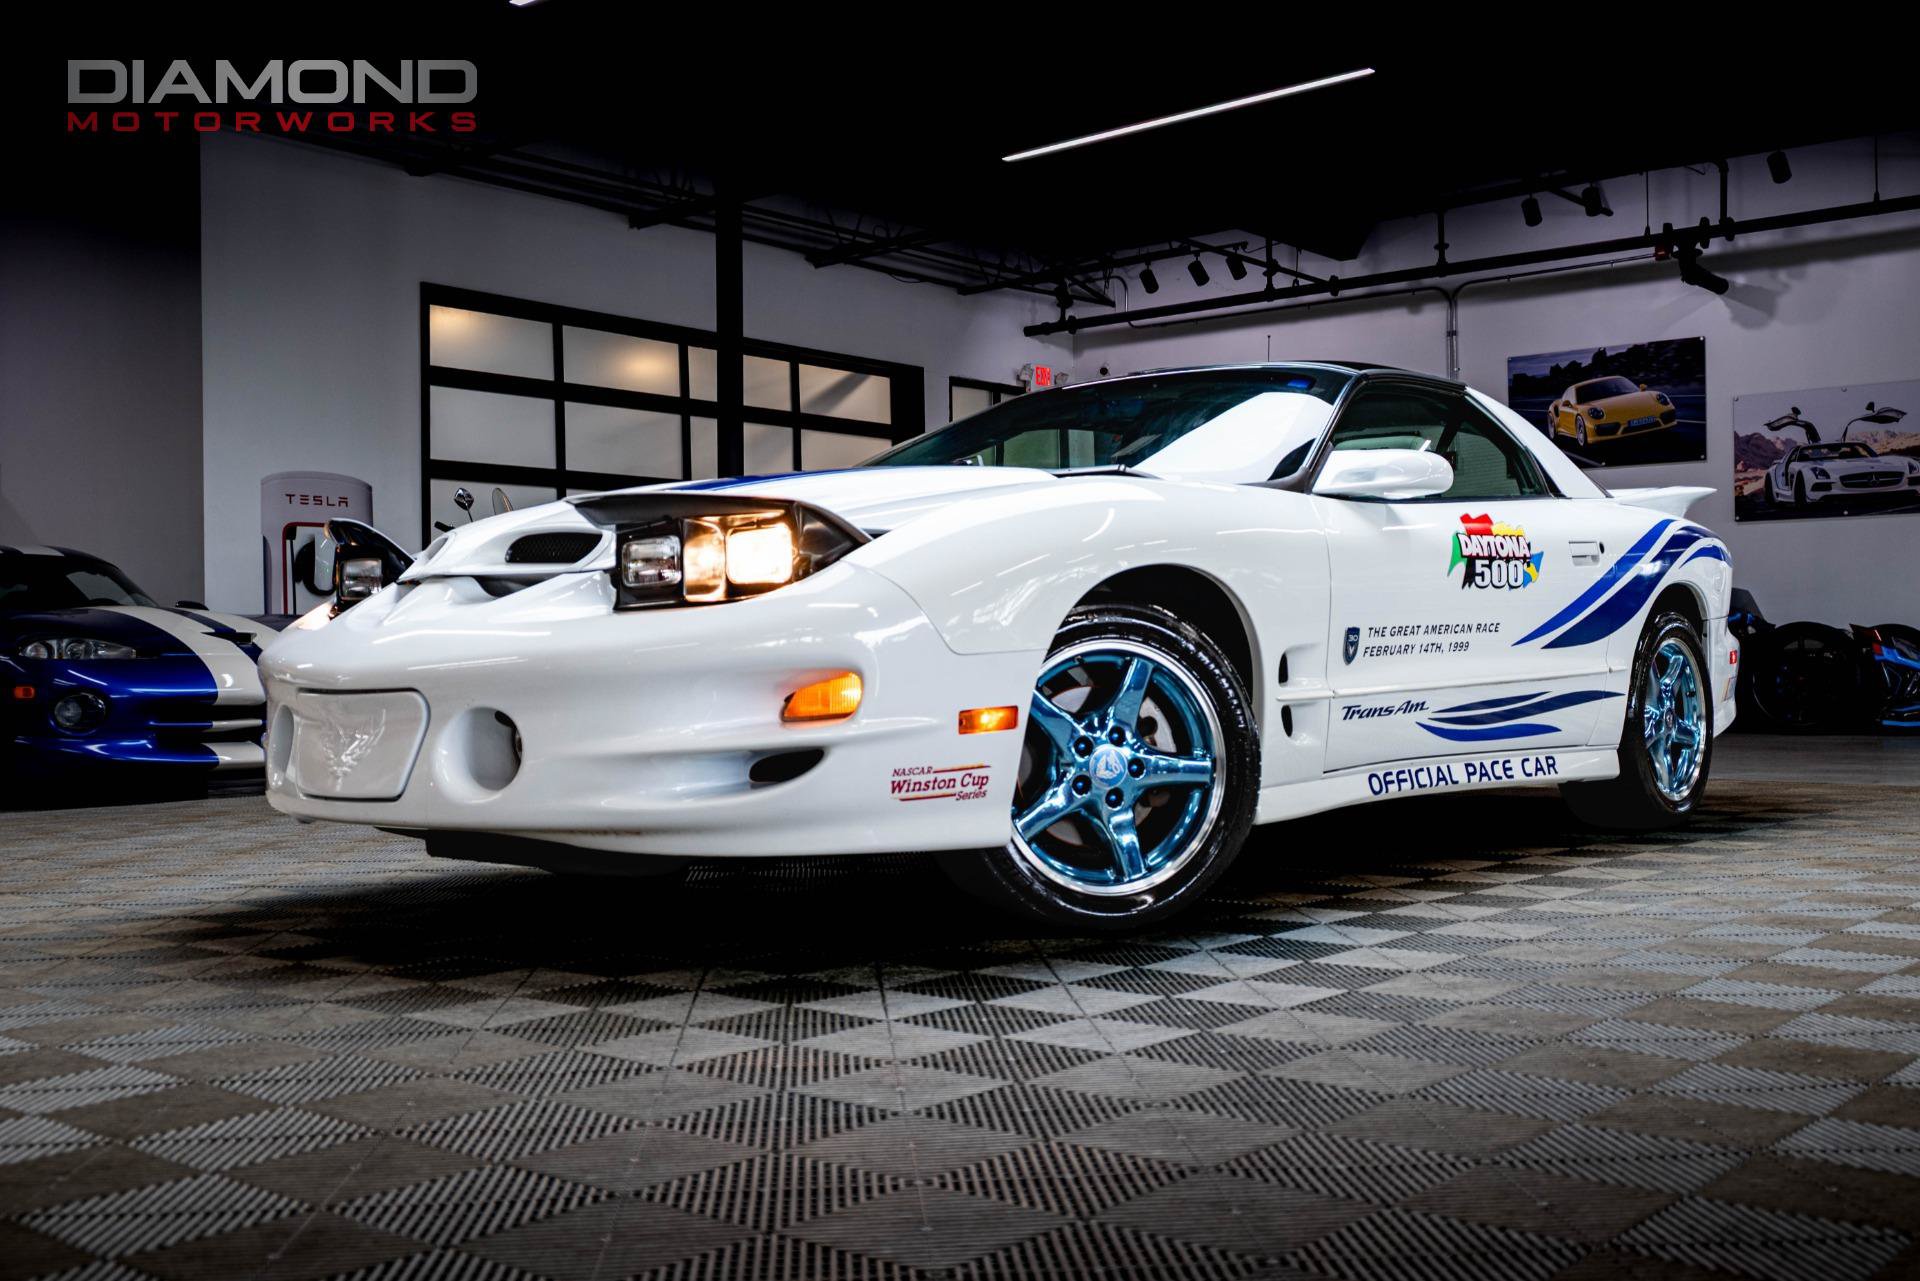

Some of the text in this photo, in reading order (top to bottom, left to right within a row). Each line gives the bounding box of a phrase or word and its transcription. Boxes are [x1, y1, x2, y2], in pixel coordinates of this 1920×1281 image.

[1035, 366, 1051, 386] EXIT
[285, 493, 349, 508] TESLA
[1456, 532, 1531, 558] DAYTONA
[1474, 558, 1524, 589] 500
[1368, 622, 1501, 638] THE GREAT AMERICAN RACE
[1363, 641, 1470, 658] FEBRUARY 14TH, 1999
[1342, 699, 1430, 721] Trans Am
[892, 766, 933, 778] NASCAR
[1368, 755, 1559, 797] OFFICIAL PACE CAR
[890, 772, 989, 794] Winston Cup
[955, 789, 987, 801] Series
